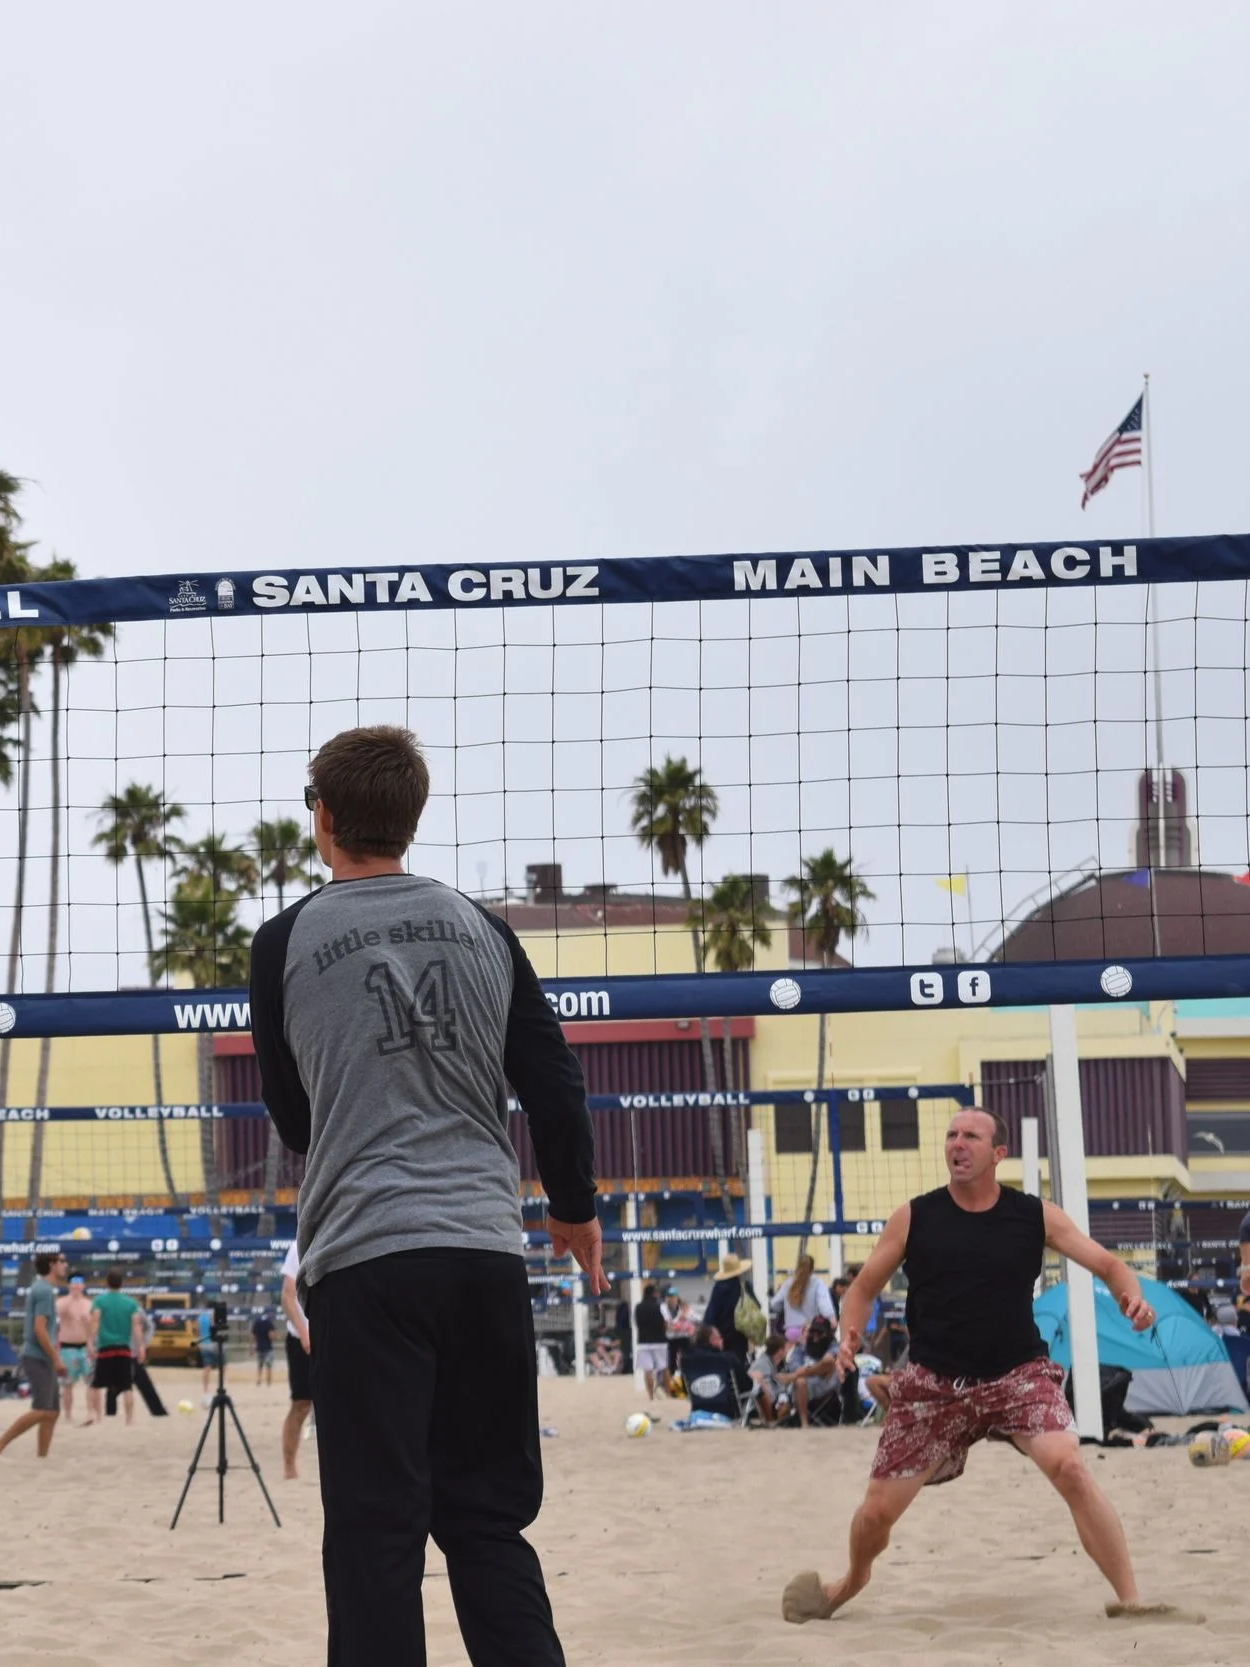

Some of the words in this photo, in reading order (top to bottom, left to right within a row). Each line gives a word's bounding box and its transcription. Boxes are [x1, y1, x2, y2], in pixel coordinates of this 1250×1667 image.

[252, 571, 434, 609] SANTA
[447, 566, 599, 602] CRUZ
[733, 555, 891, 591] MAIN
[921, 545, 1138, 585] BEACH
[312, 927, 380, 976] little
[365, 959, 457, 1056] 14
[95, 1106, 223, 1120] VOLLEYBALL
[620, 1093, 749, 1107] VOLLEYBALL
[622, 1225, 763, 1242] www.santacruzwharf.com
